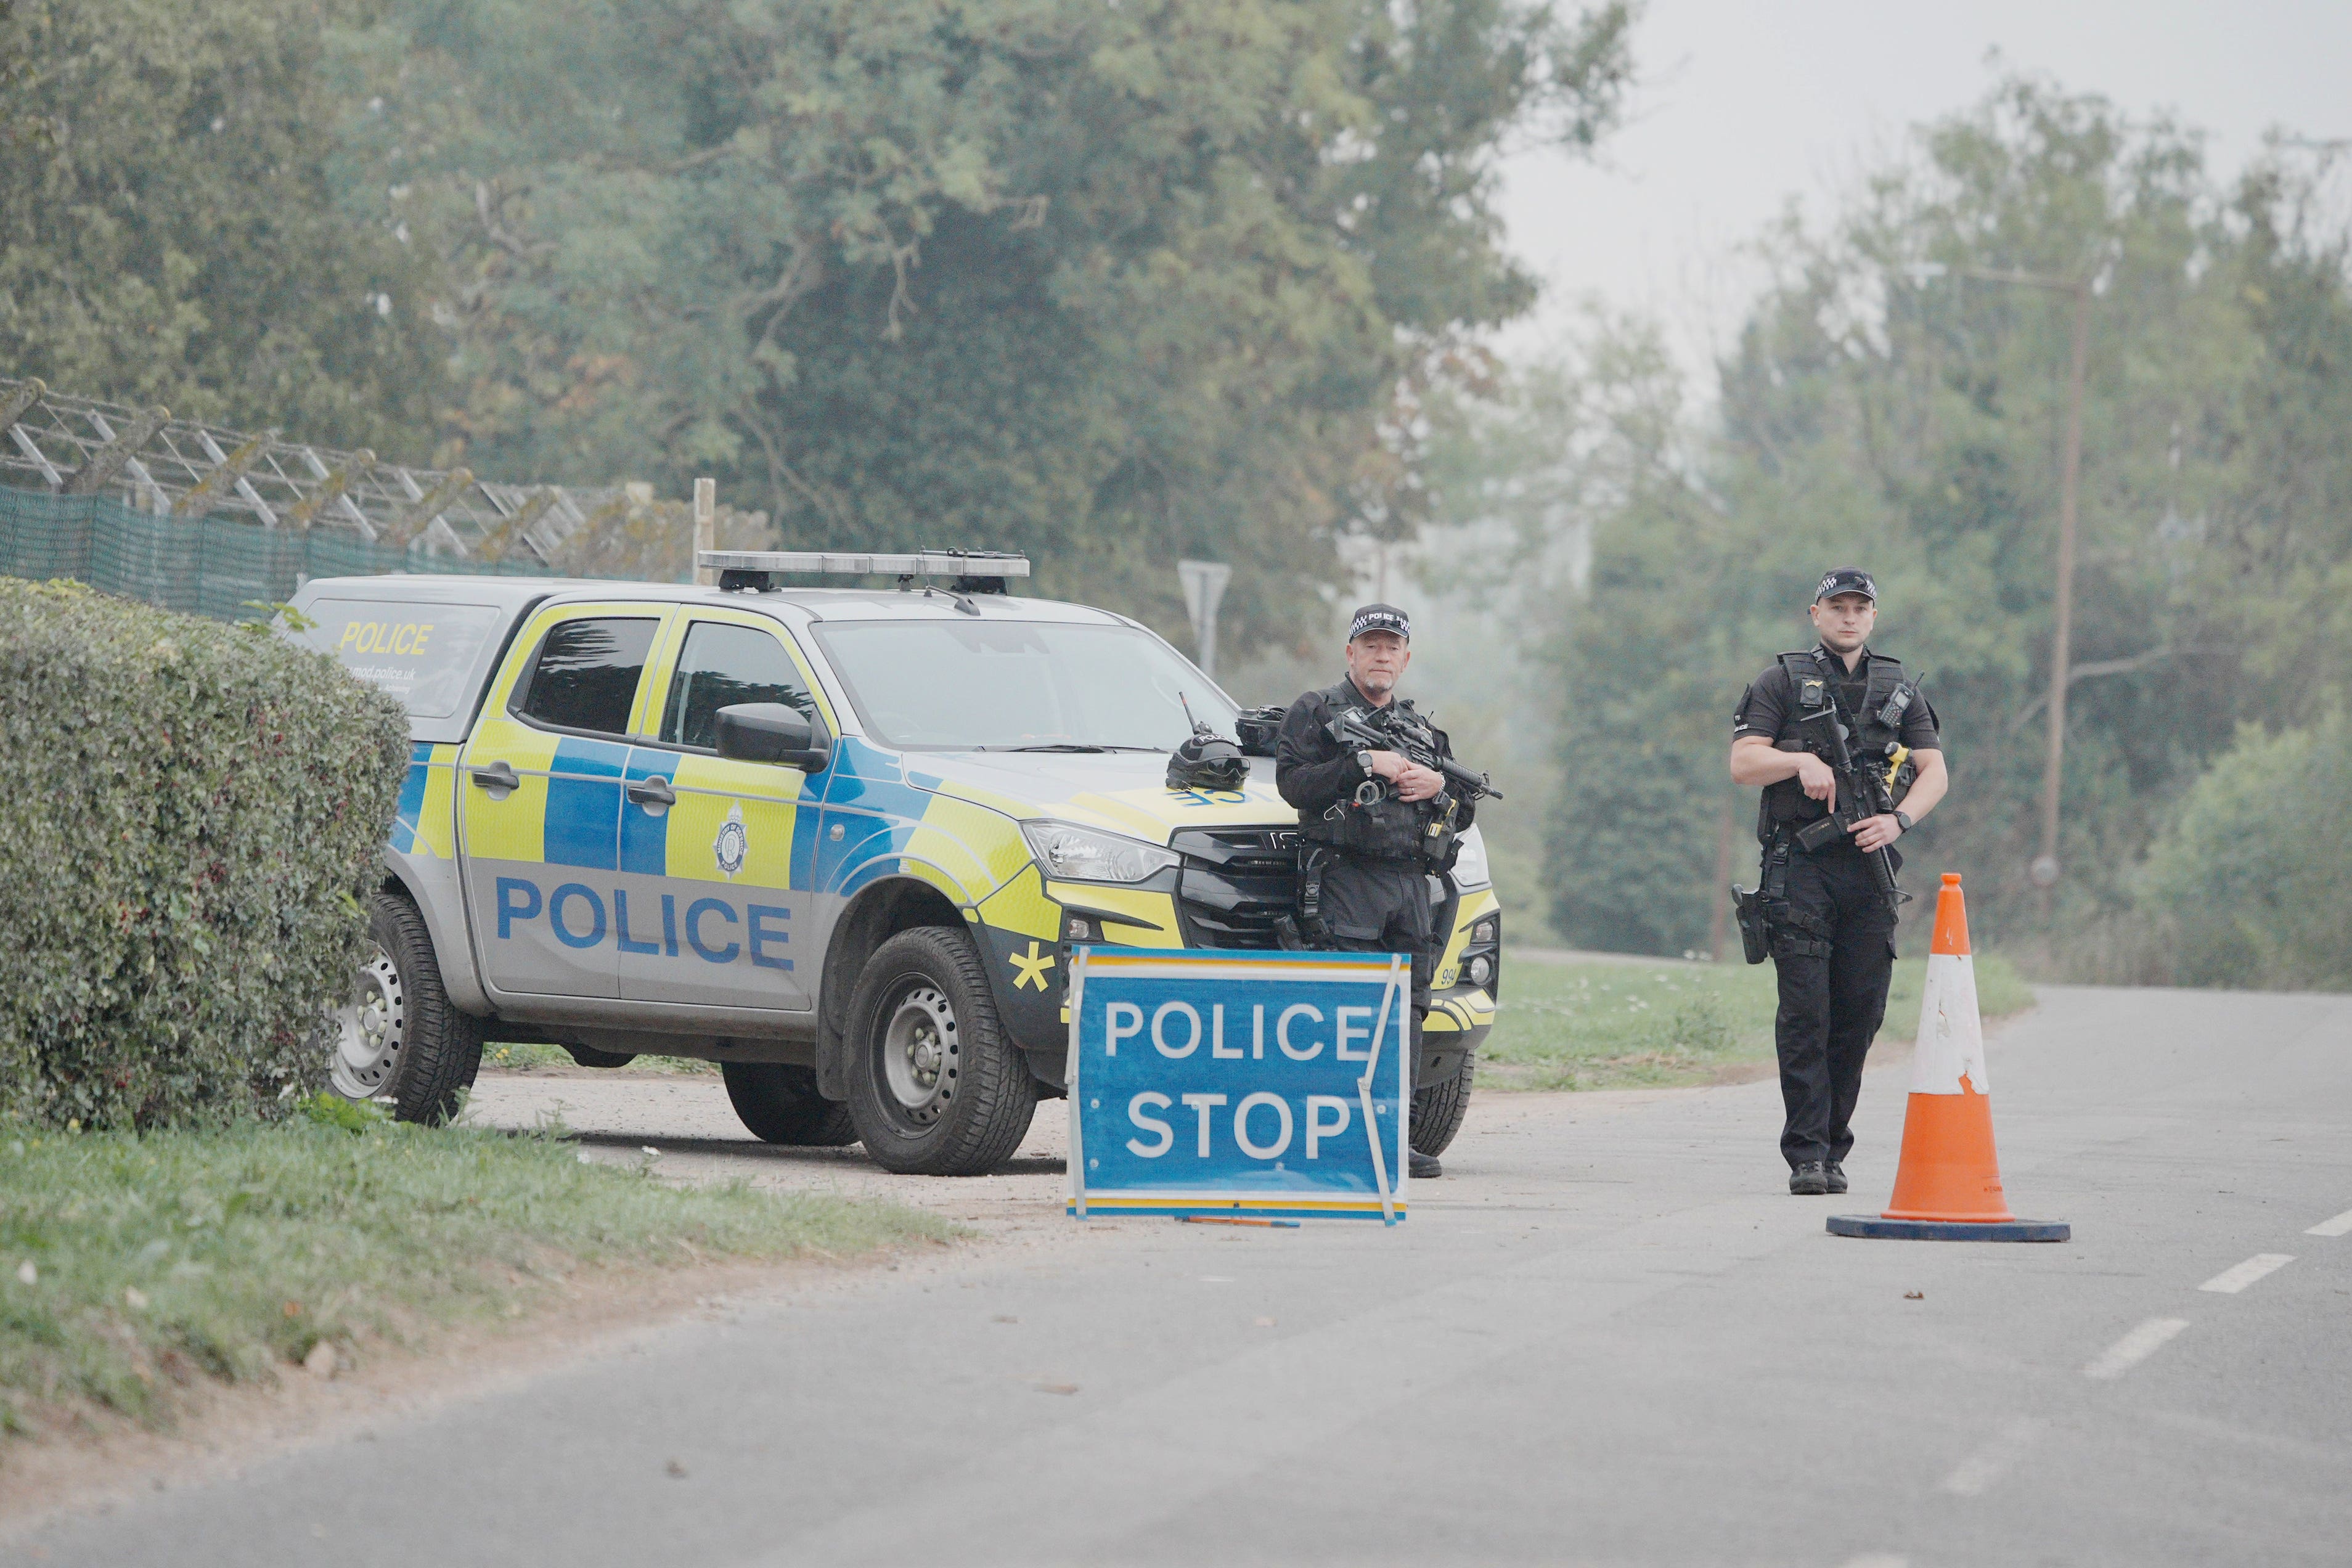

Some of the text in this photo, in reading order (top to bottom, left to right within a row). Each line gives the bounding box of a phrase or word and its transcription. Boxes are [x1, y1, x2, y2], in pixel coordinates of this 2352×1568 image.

[340, 622, 434, 655] POLICE
[721, 860, 738, 870] POLICE
[496, 876, 794, 971] POLICE
[1105, 1001, 1373, 1061] POLICE
[1126, 1092, 1351, 1159] STOP
